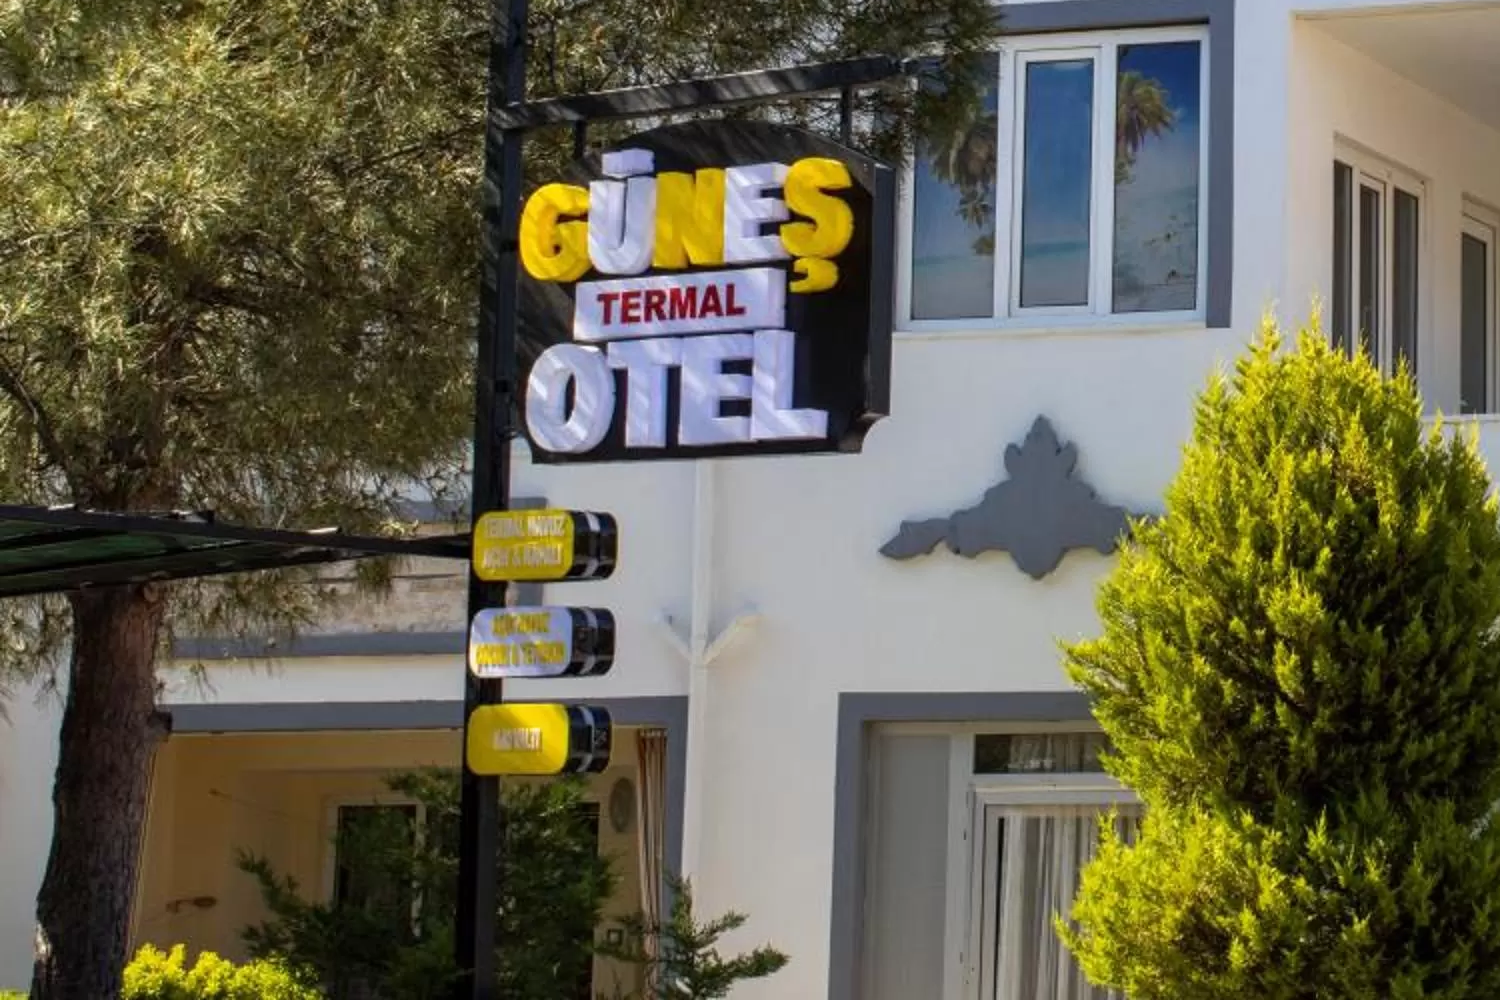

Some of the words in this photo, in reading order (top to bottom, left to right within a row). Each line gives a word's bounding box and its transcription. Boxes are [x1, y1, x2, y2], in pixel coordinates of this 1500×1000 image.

[519, 148, 854, 293] GÜNEŞ
[597, 283, 747, 325] TERMAL
[525, 329, 829, 453] OTEL
